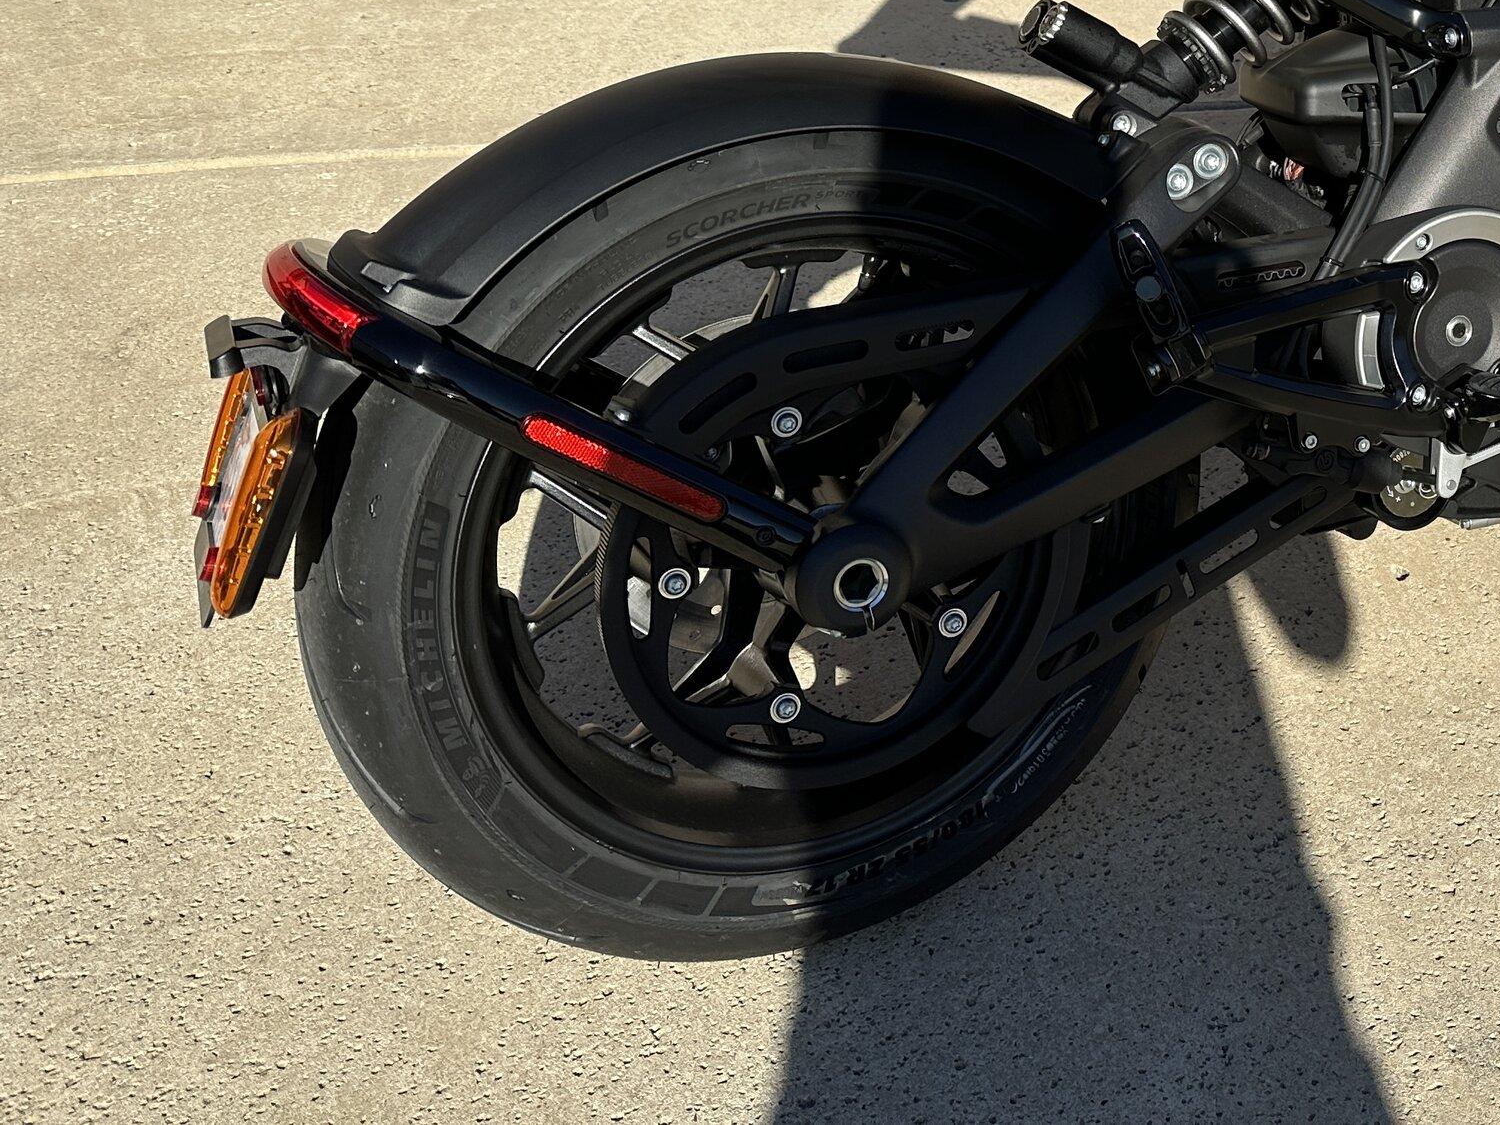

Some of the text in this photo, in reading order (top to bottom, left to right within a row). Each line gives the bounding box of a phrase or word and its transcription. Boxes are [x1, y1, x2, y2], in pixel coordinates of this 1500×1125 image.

[666, 187, 865, 248] SCORCHER SPORT
[413, 518, 468, 752] MICHELIN
